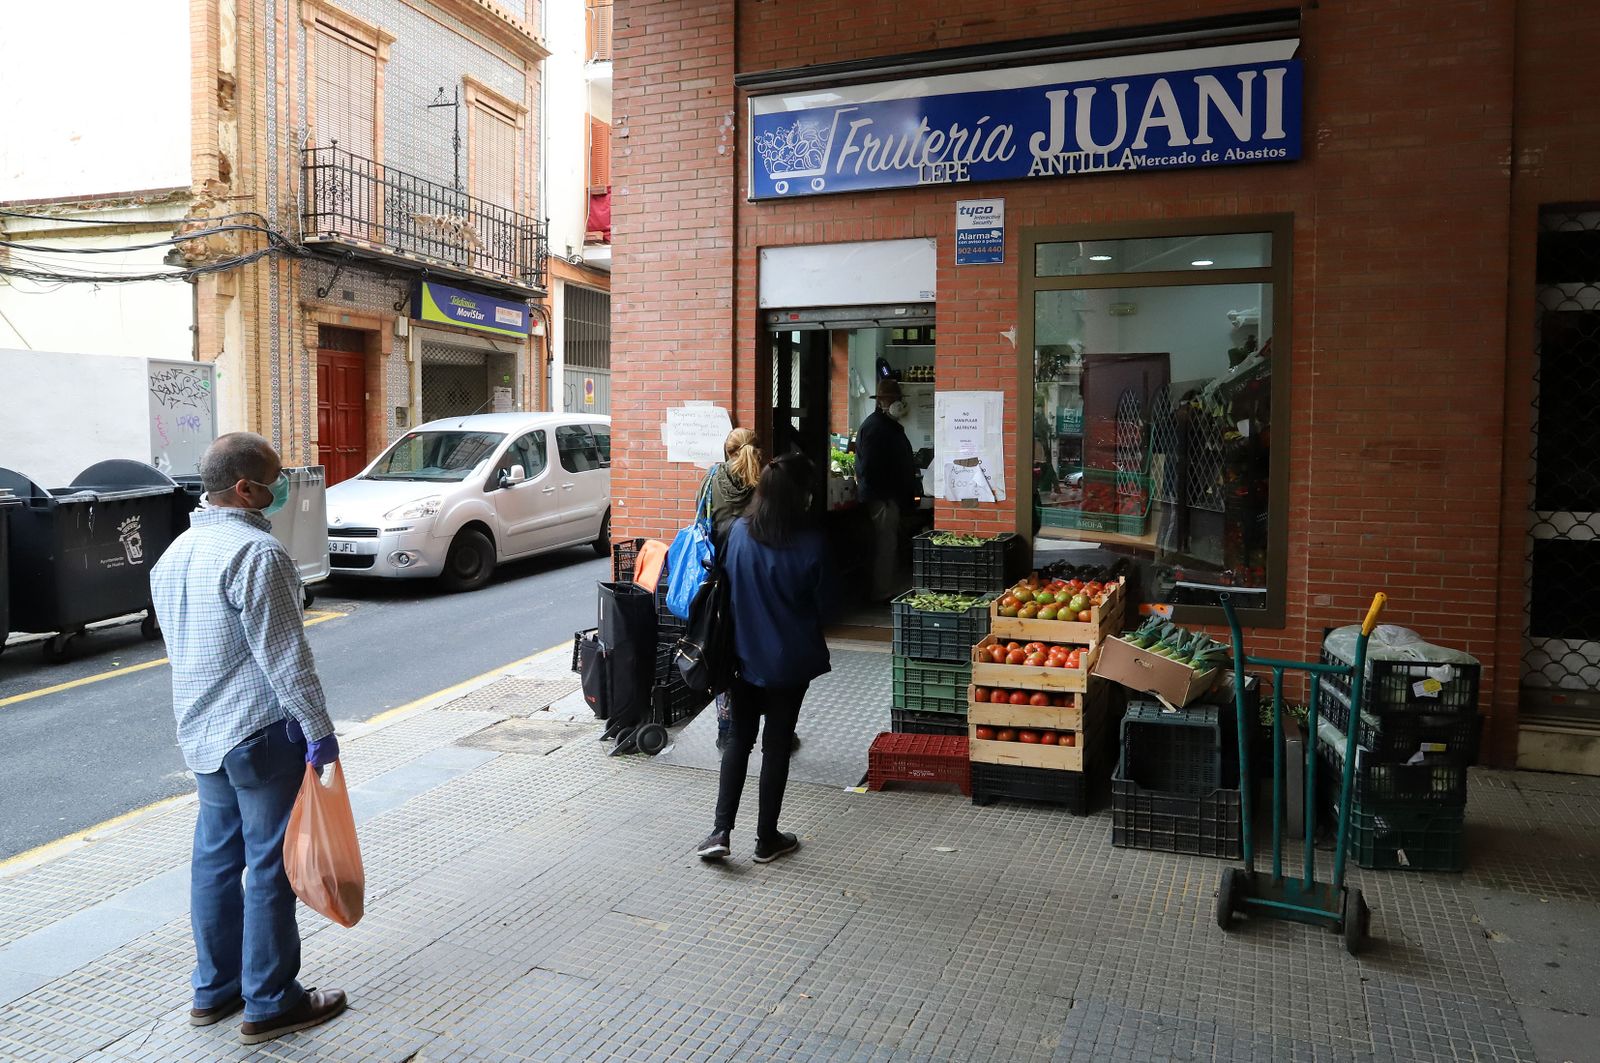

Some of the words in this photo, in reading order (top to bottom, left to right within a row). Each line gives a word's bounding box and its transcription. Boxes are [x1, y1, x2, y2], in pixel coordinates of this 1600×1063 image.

[1029, 67, 1287, 157] JUANI
[836, 115, 1016, 175] Frutería
[1027, 148, 1136, 176] ANTILLA
[1134, 152, 1196, 168] Mercado
[1201, 149, 1219, 163] de
[1224, 147, 1287, 161] Abastos
[919, 160, 970, 184] LEPE
[959, 206, 993, 217] tyco
[456, 307, 485, 320] MoviStar
[340, 543, 354, 552] JFL
